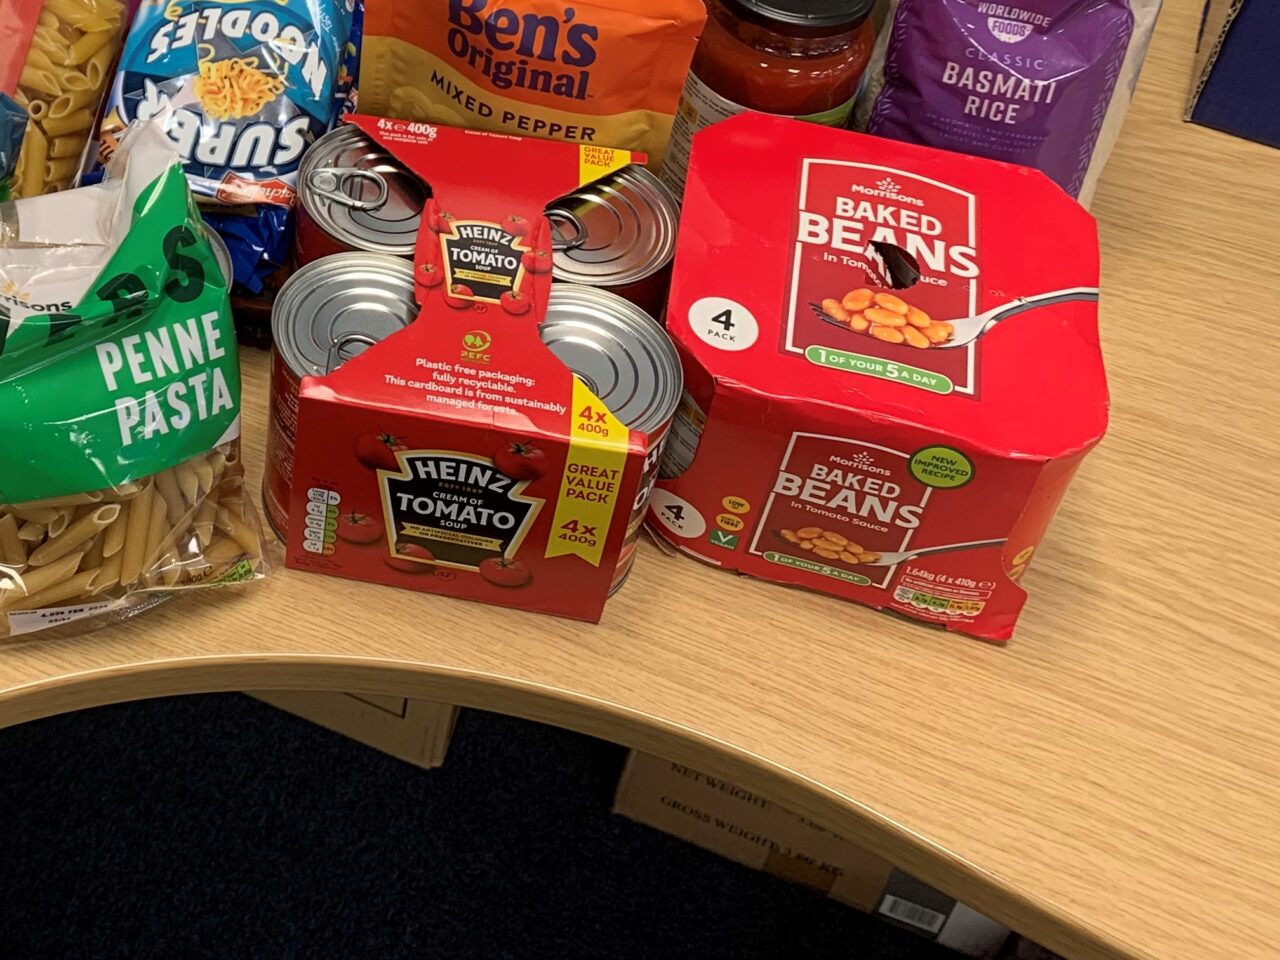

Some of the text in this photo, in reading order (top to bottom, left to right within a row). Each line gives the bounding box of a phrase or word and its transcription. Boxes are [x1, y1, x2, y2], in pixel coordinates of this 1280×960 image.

[977, 2, 1052, 28] WORLDWIDE
[991, 20, 1026, 37] FOODS
[147, 8, 327, 100] NOODLES
[447, 27, 590, 101] Original
[965, 48, 1044, 71] CLASSIC
[942, 61, 1056, 104] BASMATI
[430, 70, 596, 141] MIXED PEPPER
[964, 96, 1020, 125] RICE
[377, 118, 438, 139] 4x 400g
[583, 146, 615, 155] GREAT
[584, 153, 615, 162] VALUE
[584, 158, 611, 168] PACK
[851, 184, 925, 207] Morrisons
[835, 196, 942, 237] BAKED
[460, 226, 513, 245] HEINZ
[797, 210, 980, 278] BEANS
[451, 247, 517, 269] TOMATO
[470, 245, 490, 253] CREAM
[823, 252, 837, 263] In
[920, 275, 948, 287] uce
[711, 308, 735, 331] 4
[707, 329, 736, 343] PACK
[96, 310, 226, 392] PENNE
[416, 358, 536, 387] Plastic free packaging:
[819, 348, 937, 387] 1 OF YOUR 5 A DAY
[432, 372, 517, 394] fully recyclable.
[384, 374, 567, 416] This cardboard is from sustainably
[426, 394, 519, 416] managed forests.
[114, 368, 235, 447] PASTA
[578, 406, 608, 425] 4x
[578, 423, 609, 438] 400g
[829, 454, 891, 477] Morrisons
[914, 459, 969, 477] IMPROVED
[931, 455, 957, 466] NEW
[414, 460, 512, 494] HEINZ
[567, 463, 620, 480] GREAT
[810, 463, 901, 499] BAKED
[922, 468, 956, 481] RECIPE
[566, 476, 615, 492] VALUE
[432, 491, 484, 506] CREAM OF
[566, 488, 609, 504] PACK
[728, 499, 745, 507] LOW
[772, 471, 923, 529] BEANS
[396, 492, 515, 530] TOMATO
[661, 512, 684, 531] PACK
[664, 504, 685, 521] 4
[791, 501, 889, 533] In Tomato Sauce
[421, 527, 461, 539] ARTIFICIAL
[440, 520, 468, 530] SOUP
[560, 518, 598, 537] 4x
[429, 533, 483, 546] PRESERVATIVES
[557, 533, 597, 548] 400g
[795, 561, 820, 571] YOUR
[841, 573, 860, 581] DAY
[906, 566, 935, 581] 1.64kg
[671, 762, 700, 782] NET
[660, 795, 710, 825] GROSS
